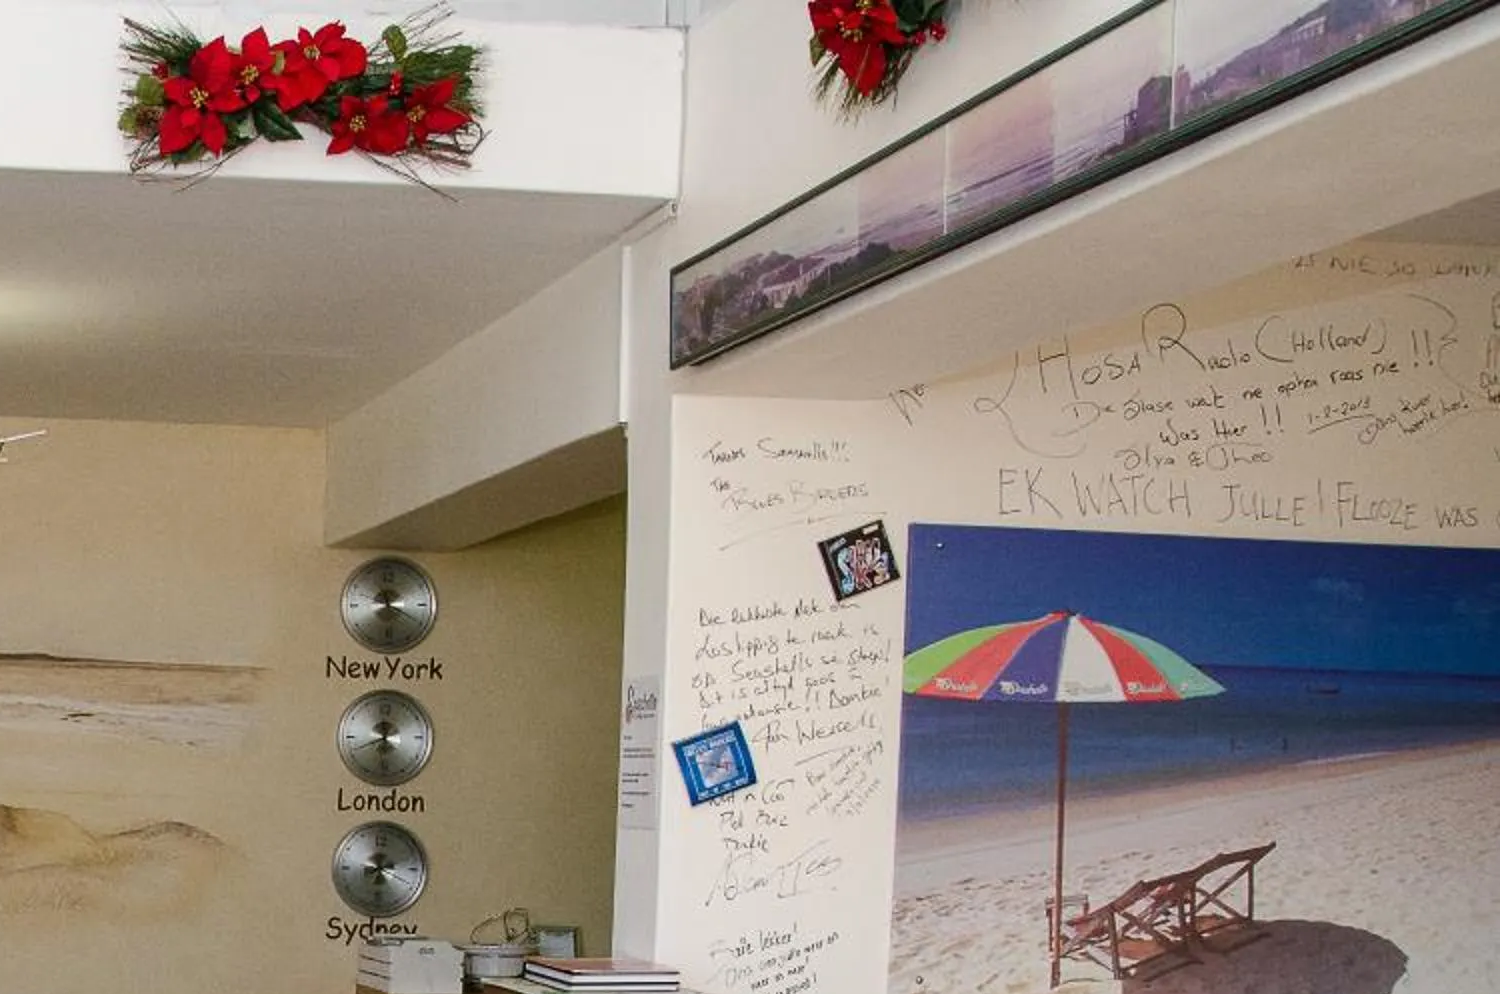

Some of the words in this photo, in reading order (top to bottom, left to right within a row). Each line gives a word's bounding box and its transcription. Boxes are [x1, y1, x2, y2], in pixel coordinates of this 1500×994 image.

[998, 466, 1063, 519] EK
[1070, 470, 1192, 519] WATCH
[1434, 505, 1480, 531] WAS
[325, 655, 380, 679] New
[384, 656, 443, 680] York
[337, 788, 426, 813] London
